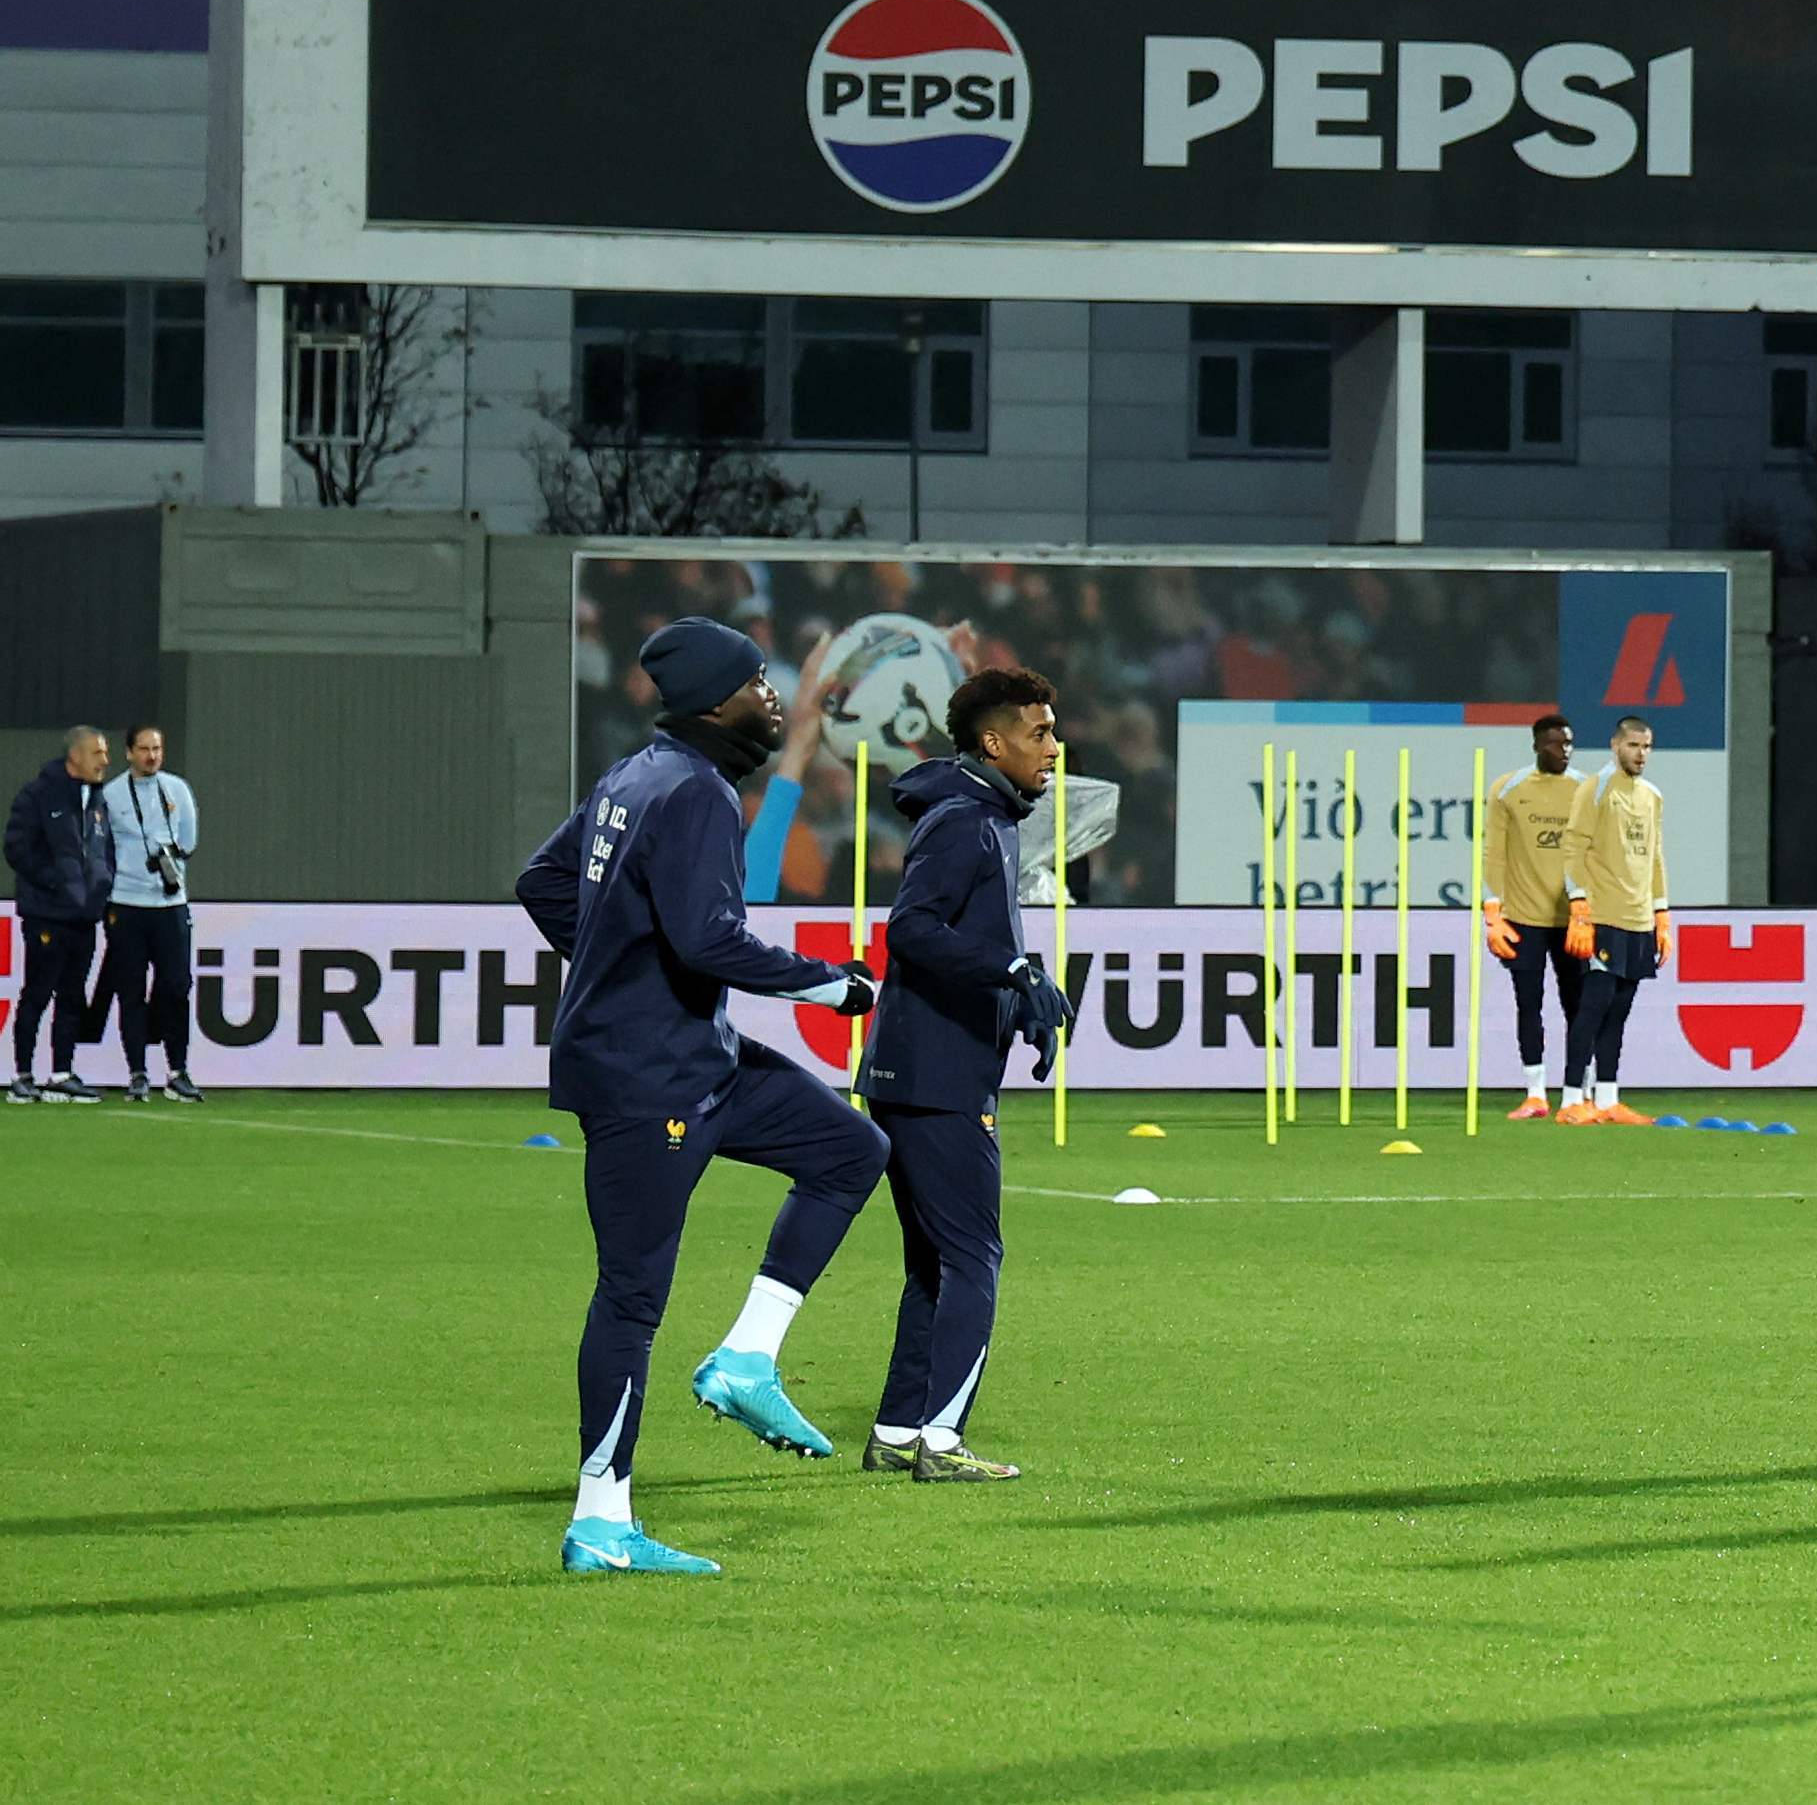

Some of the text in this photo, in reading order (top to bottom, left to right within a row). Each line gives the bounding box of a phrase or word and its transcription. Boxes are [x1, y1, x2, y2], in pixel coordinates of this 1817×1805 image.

[822, 72, 1015, 121] PEPSI
[1142, 34, 1694, 178] PEPSI
[75, 948, 564, 1048] ÜRTH
